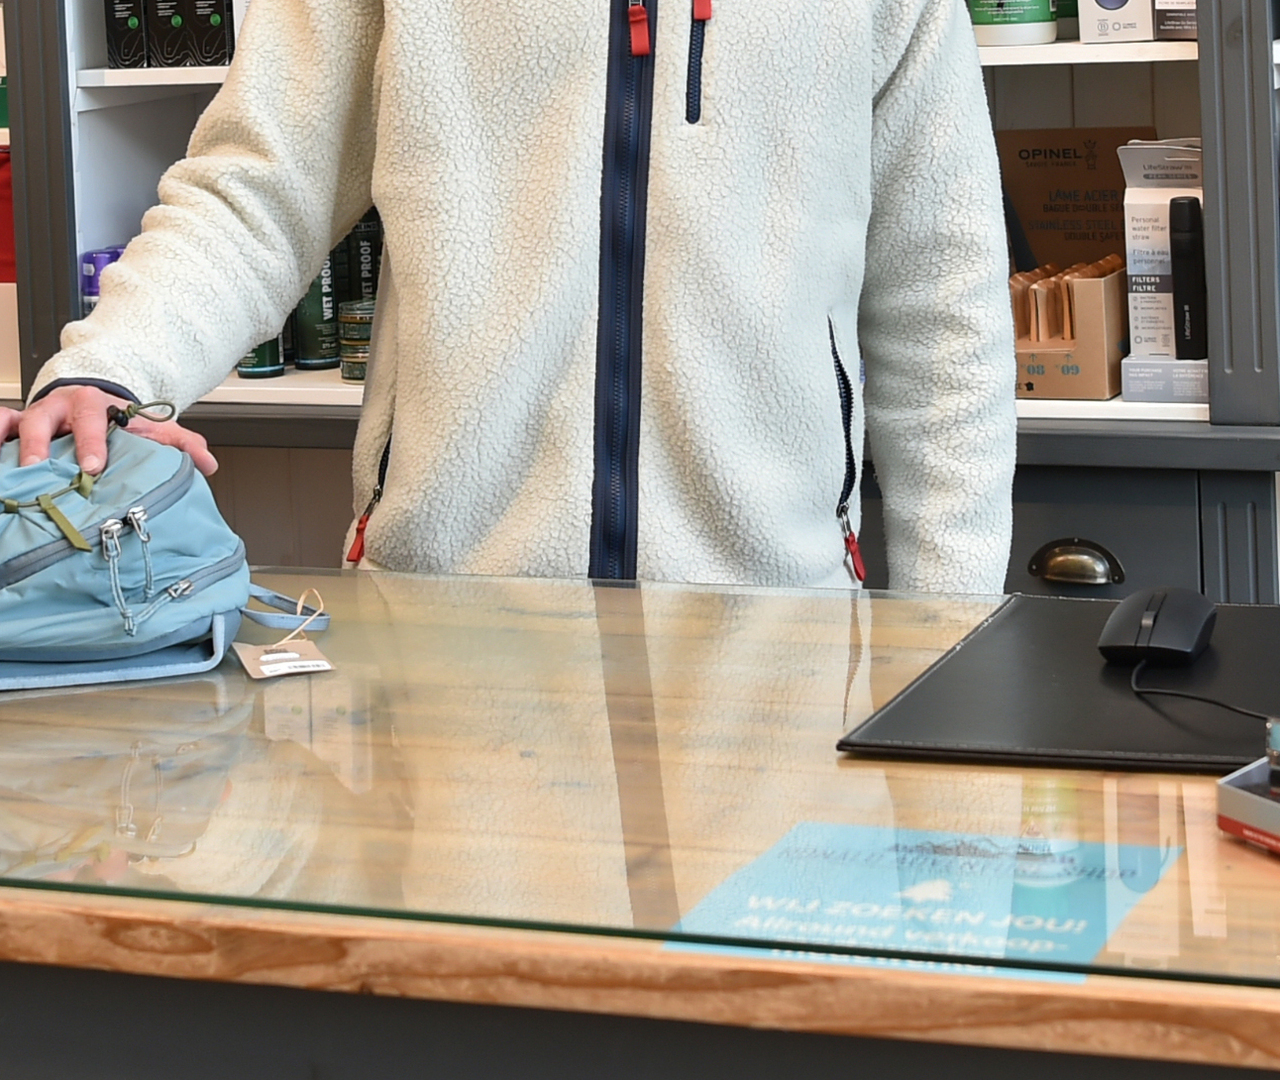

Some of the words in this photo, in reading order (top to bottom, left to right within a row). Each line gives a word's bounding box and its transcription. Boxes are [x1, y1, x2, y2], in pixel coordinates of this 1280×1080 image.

[1018, 148, 1082, 161] OPINEL
[360, 240, 372, 277] PROOF
[323, 296, 333, 320] WET
[735, 915, 896, 940] Allround
[905, 929, 1070, 953] verkoop-
[748, 896, 823, 915] WIJ
[831, 901, 987, 923] ZOEKEN
[1003, 915, 1085, 935] JOU!
